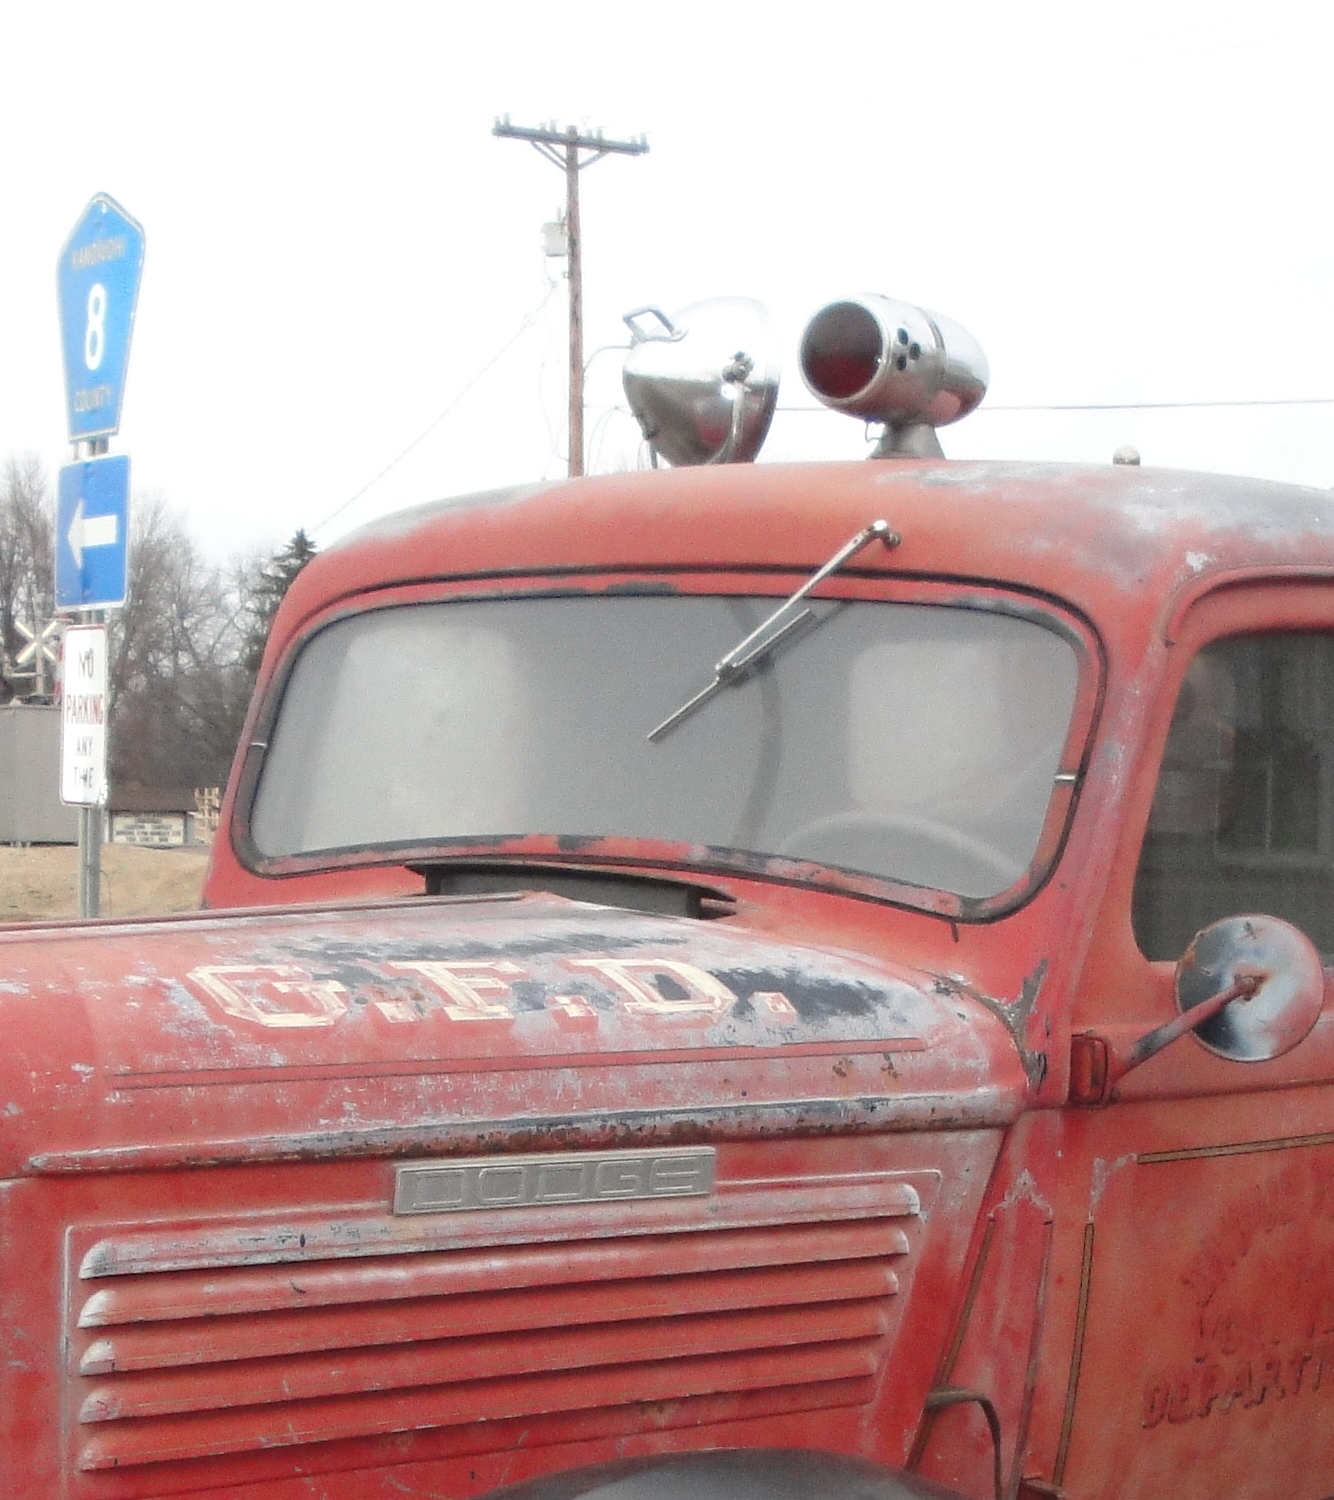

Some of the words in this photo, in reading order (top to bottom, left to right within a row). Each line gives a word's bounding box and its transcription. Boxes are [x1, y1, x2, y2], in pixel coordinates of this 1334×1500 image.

[86, 284, 106, 371] 8
[75, 386, 111, 412] COUNTY
[79, 648, 95, 678] NO
[65, 694, 104, 725] PARKING
[76, 736, 94, 756] ANY
[412, 1156, 702, 1208] DODGE
